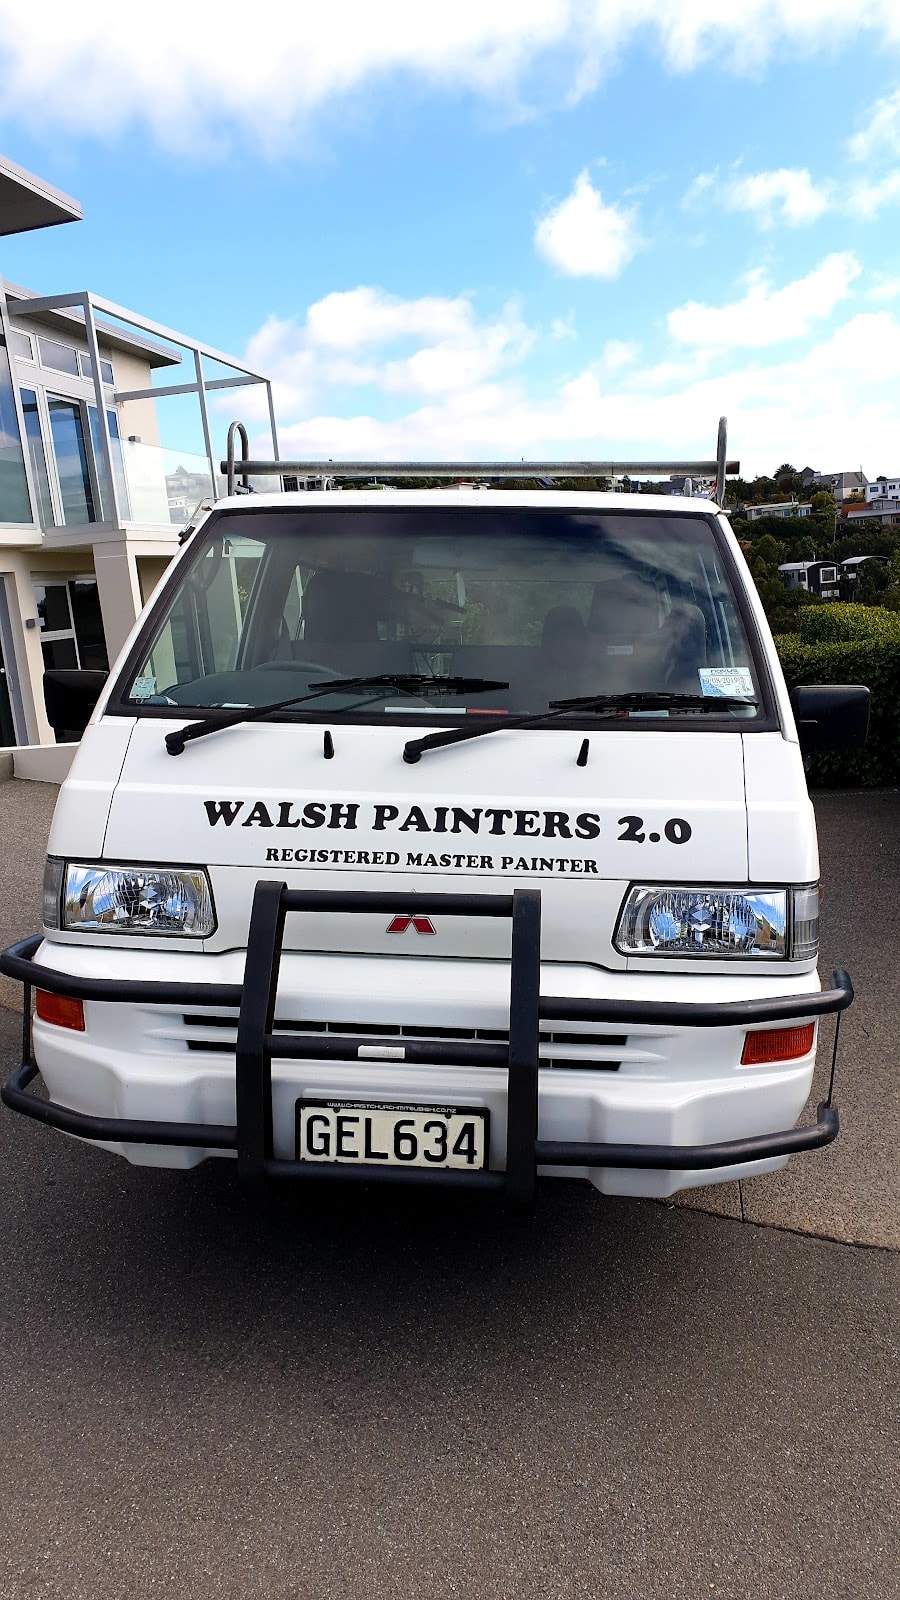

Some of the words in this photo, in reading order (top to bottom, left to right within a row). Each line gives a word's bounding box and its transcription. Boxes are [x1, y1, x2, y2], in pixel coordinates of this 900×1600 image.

[203, 800, 361, 830] WALSH
[371, 804, 601, 840] PAINTERS
[617, 815, 692, 846] 2.0
[265, 847, 400, 865] REGISTERED
[405, 852, 495, 870] MASTER
[501, 856, 600, 873] PAINTER
[306, 1114, 478, 1165] GEL634
